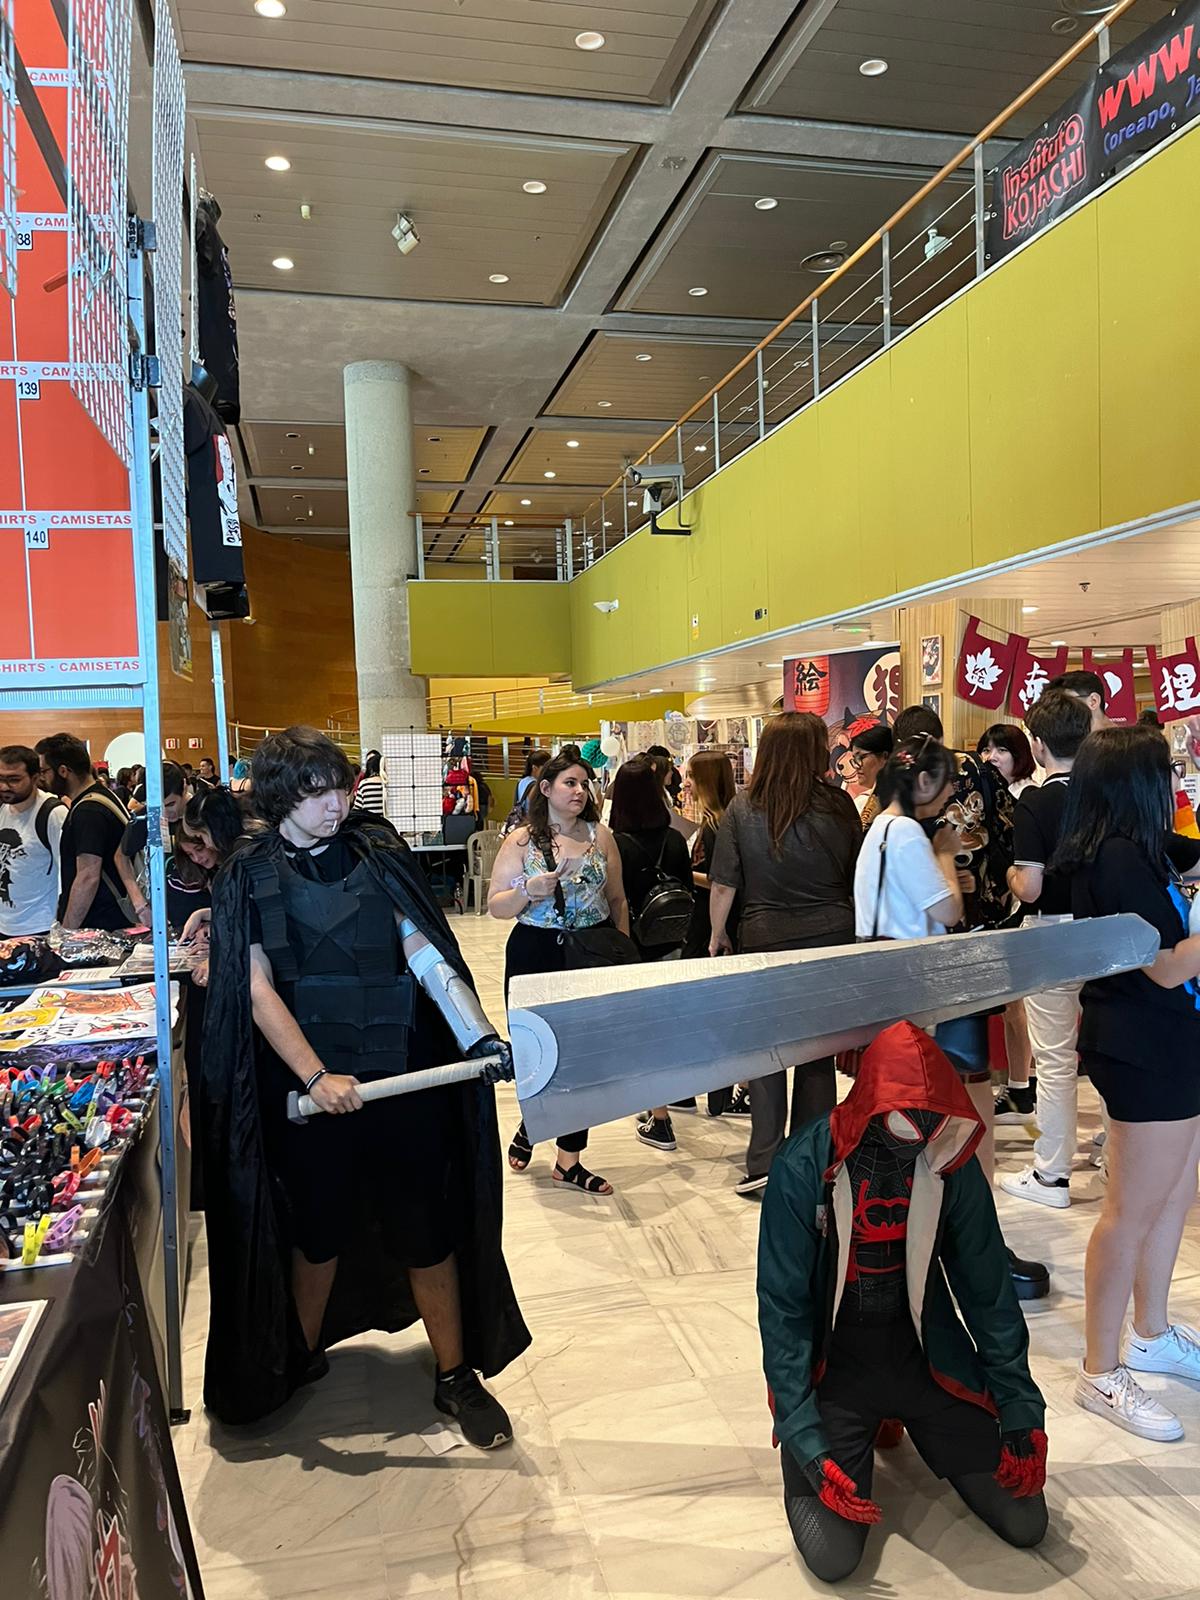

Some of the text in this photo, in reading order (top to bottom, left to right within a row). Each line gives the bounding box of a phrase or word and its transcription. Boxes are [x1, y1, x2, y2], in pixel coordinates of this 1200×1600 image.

[1005, 118, 1080, 201] Instituto
[1007, 146, 1083, 233] KOJACHI
[18, 382, 38, 395] 139
[50, 515, 132, 525] CAMISETAS
[26, 530, 46, 543] 140
[59, 660, 140, 672] CAMISETAS
